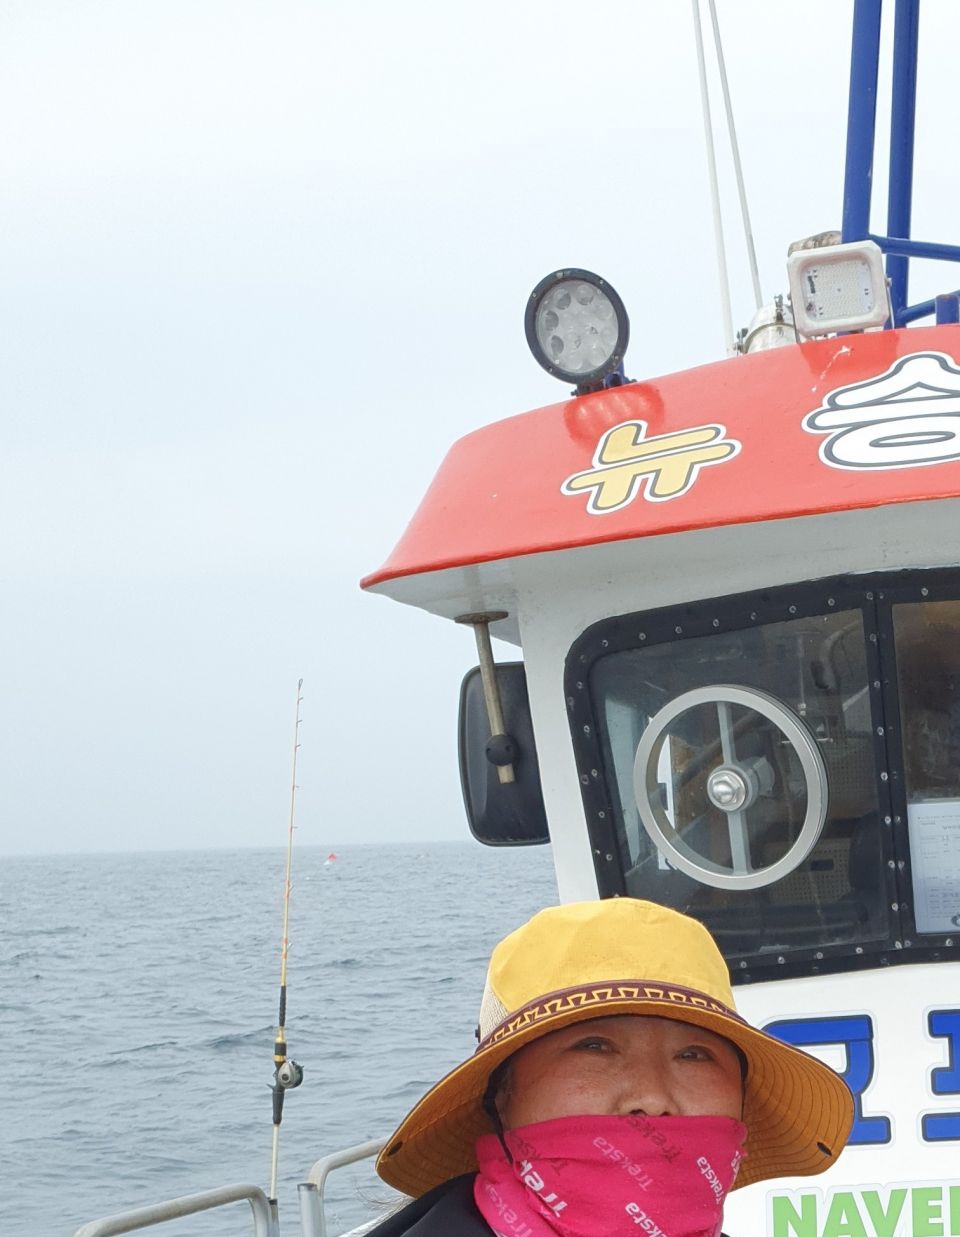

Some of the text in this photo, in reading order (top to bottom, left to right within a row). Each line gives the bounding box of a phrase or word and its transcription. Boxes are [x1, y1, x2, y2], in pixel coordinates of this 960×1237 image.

[562, 418, 741, 514] 뉴
[592, 1136, 656, 1192] Treksta
[696, 1156, 723, 1204] Treksta
